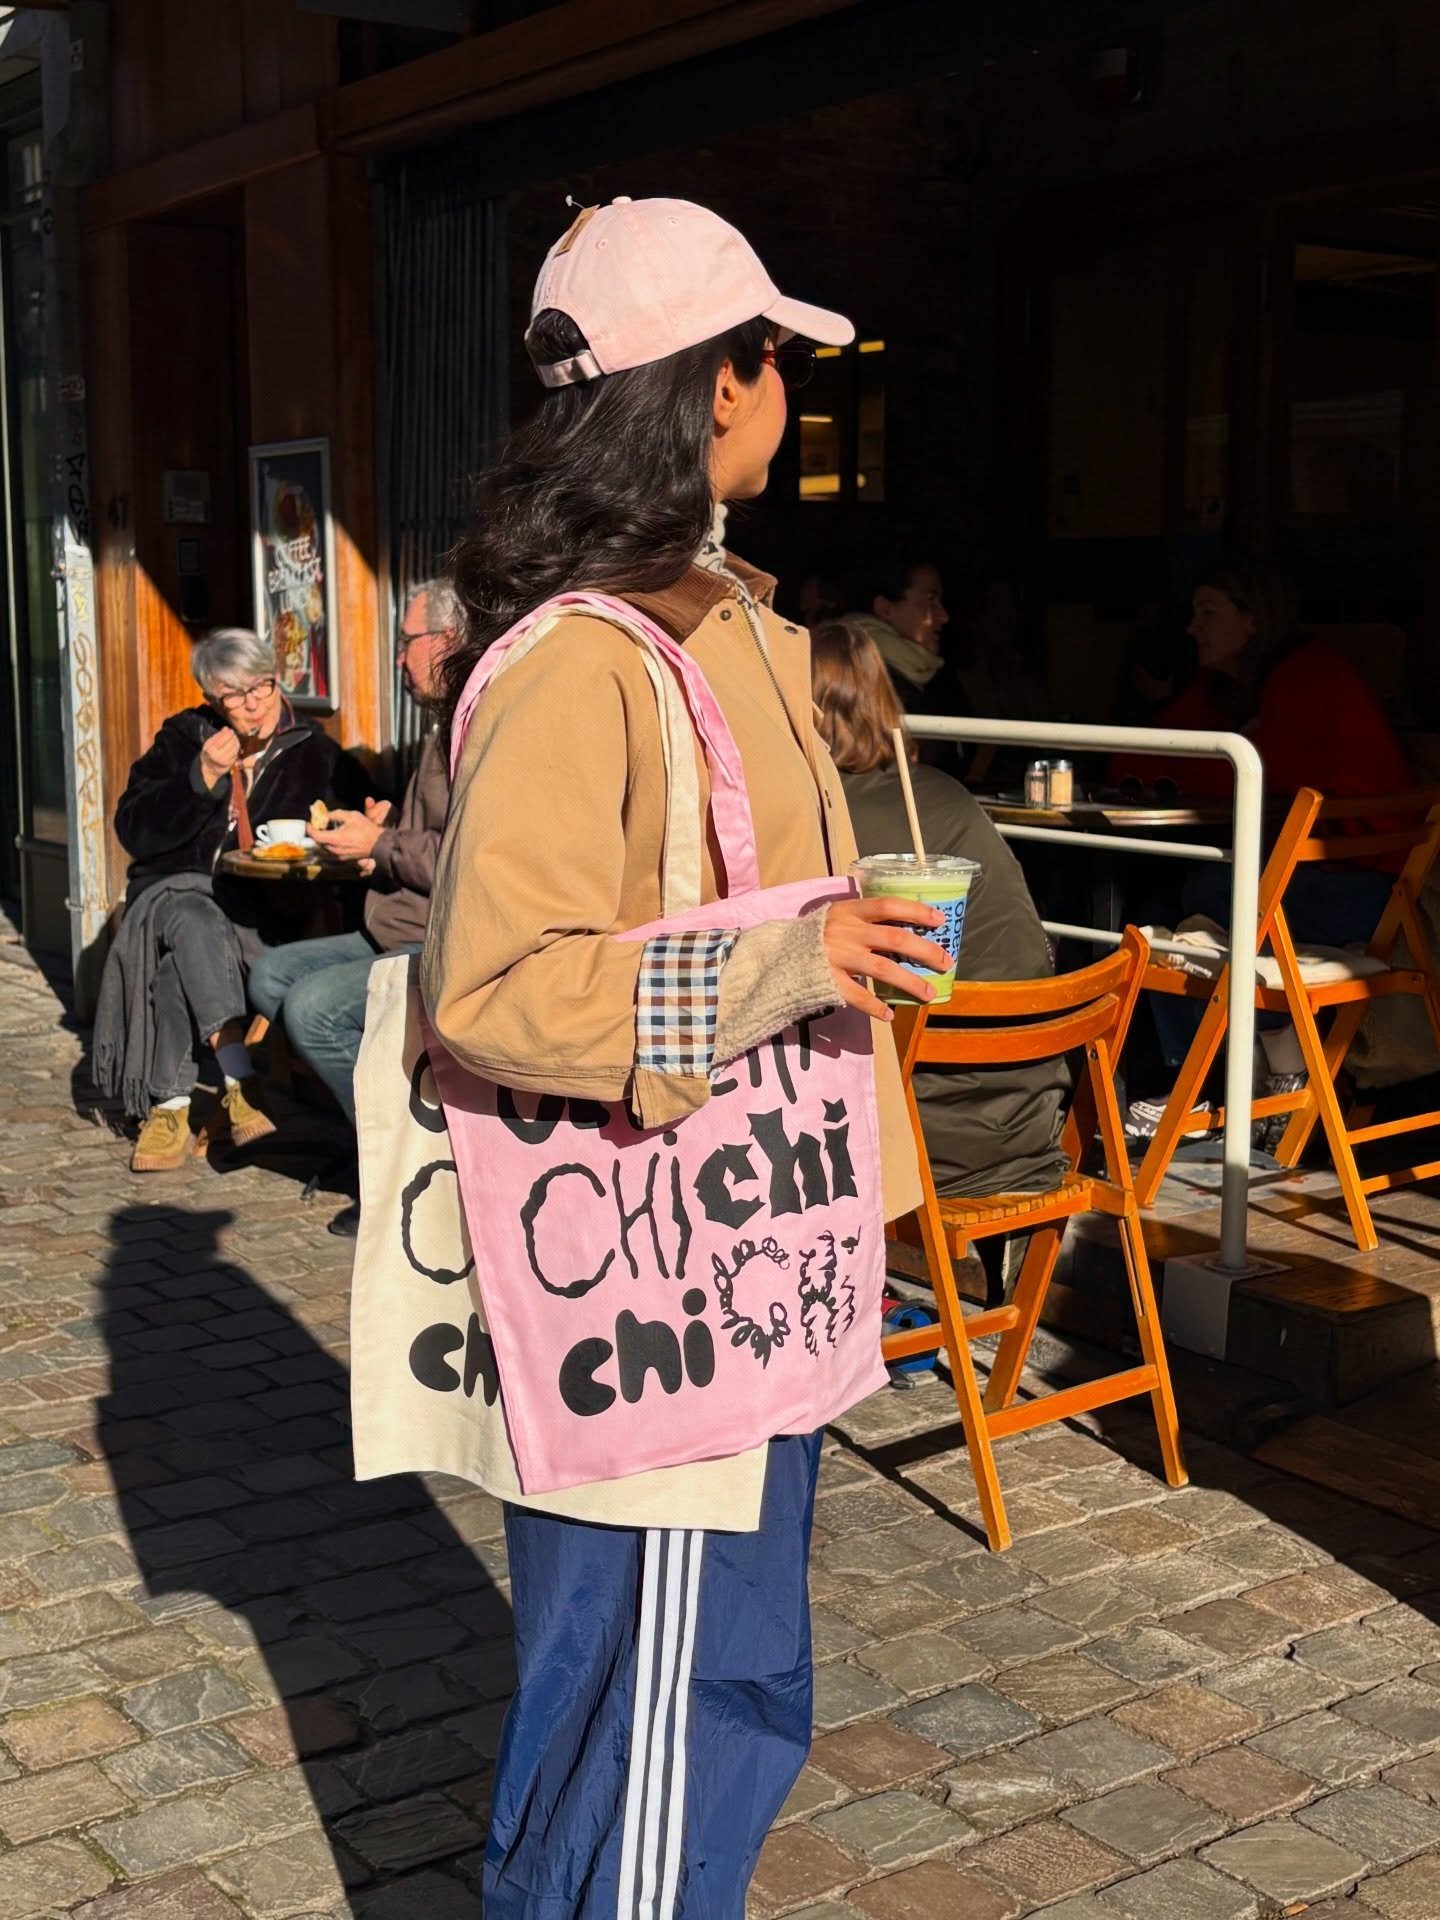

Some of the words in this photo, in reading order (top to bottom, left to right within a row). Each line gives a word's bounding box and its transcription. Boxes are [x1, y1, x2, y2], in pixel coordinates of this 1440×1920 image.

[692, 1098, 859, 1229] chi
[409, 1312, 499, 1407] ch
[559, 1287, 716, 1416] chi
